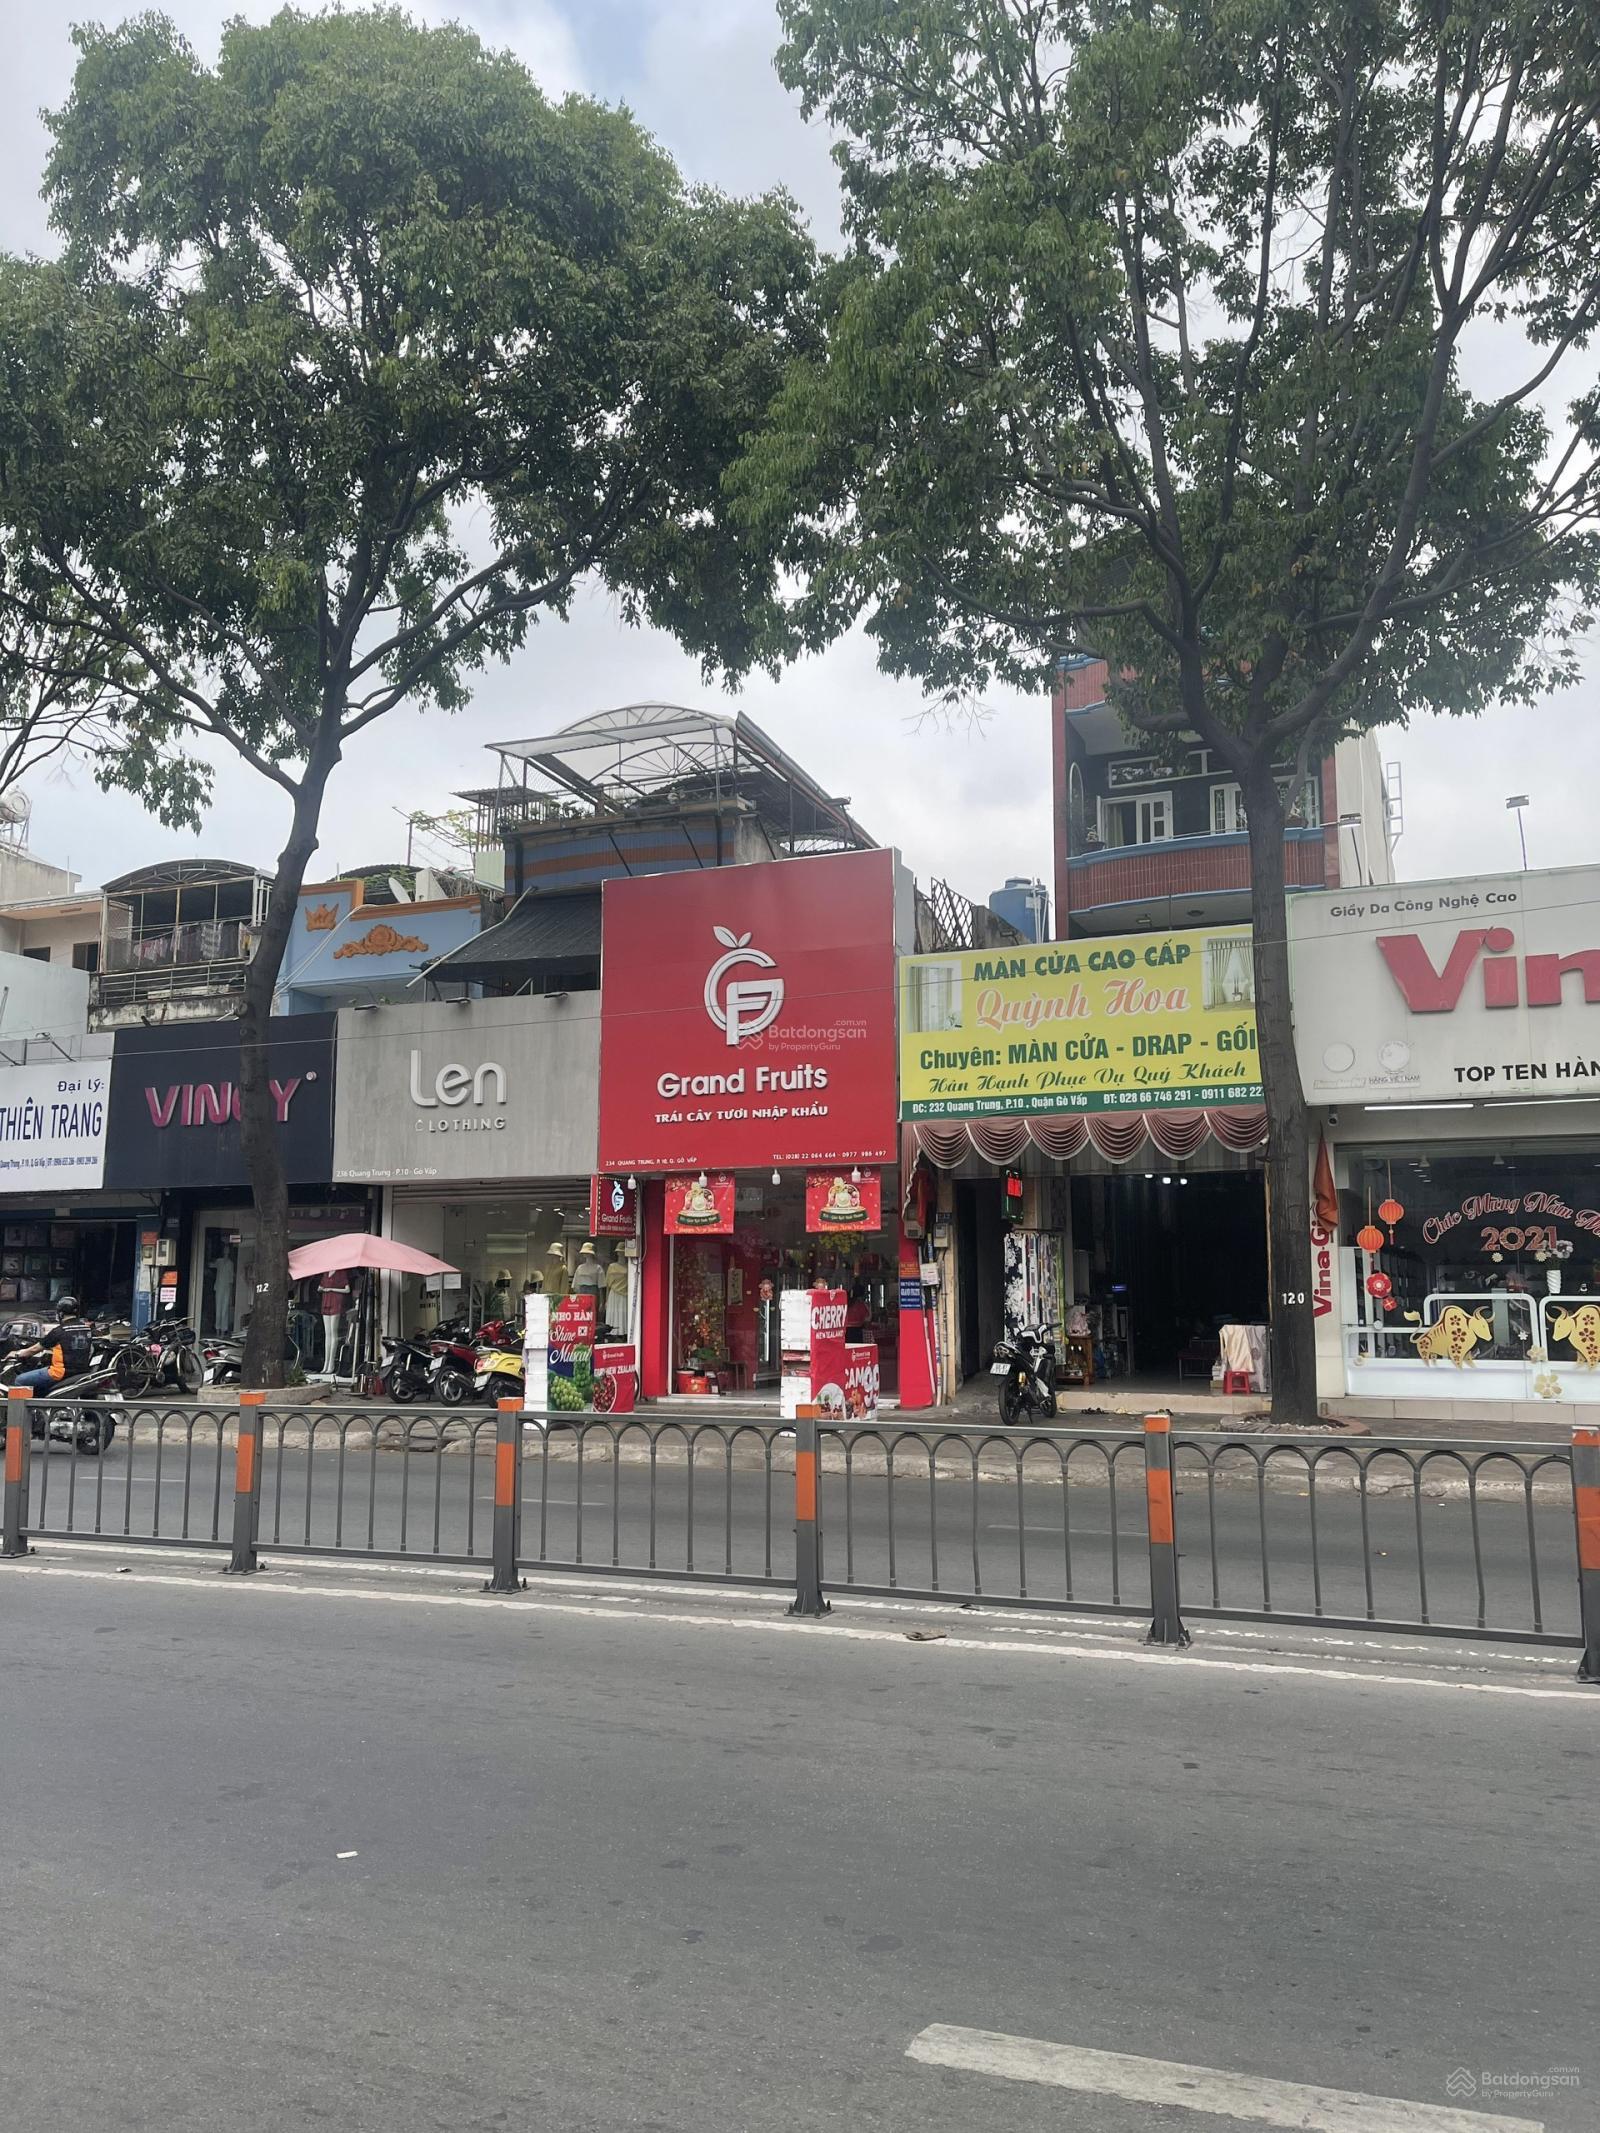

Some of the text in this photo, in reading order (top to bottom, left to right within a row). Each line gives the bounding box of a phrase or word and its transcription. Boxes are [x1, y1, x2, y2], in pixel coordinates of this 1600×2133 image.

[1370, 903, 1390, 914] Da
[1394, 899, 1433, 911] Công
[1439, 894, 1479, 908] Nghệ
[1485, 892, 1517, 904] Cao
[974, 939, 1191, 981] MÀN CỬA CAO CẤP
[975, 977, 1190, 1032] Quỳnh Hoa
[920, 1046, 1001, 1070] Chuyên:
[1008, 1039, 1057, 1065] MÀN
[1065, 1032, 1109, 1060] CỬA
[1133, 1033, 1192, 1057] DRAP
[1217, 1021, 1256, 1052] GỐI
[410, 1050, 507, 1107] Len
[657, 1063, 829, 1098] Grand Fruits
[977, 1073, 1029, 1092] Hạnh
[1036, 1071, 1087, 1090] Phục
[1094, 1068, 1125, 1086] Vụ
[1133, 1065, 1171, 1085] Quý
[1178, 1061, 1246, 1080] Khách
[1454, 1066, 1496, 1083] TOP
[1502, 1063, 1548, 1080] TEN
[57, 1078, 105, 1094] Đại lý:
[1103, 1094, 1118, 1105] ĐT:
[1120, 1092, 1138, 1103] 028
[1139, 1092, 1152, 1103] 66
[1154, 1091, 1172, 1102] 746
[1174, 1089, 1192, 1101] 291
[1201, 1088, 1224, 1100] 0911
[1228, 1086, 1247, 1098] 682
[1249, 1085, 1265, 1097] 22
[144, 1078, 301, 1128] VINY
[654, 1101, 828, 1124] TRÁI CÂY TƯƠI NHẬP KHẨU
[929, 1102, 945, 1113] 232
[946, 1101, 974, 1112] Quang
[976, 1100, 1004, 1111] Trung,
[1006, 1098, 1024, 1109] P.10
[1032, 1096, 1054, 1109] Quận
[1056, 1096, 1069, 1107] Gò
[1071, 1094, 1088, 1107] Vấp
[0, 1096, 103, 1141] THIÊN TRANG
[349, 1169, 371, 1178] Quang
[372, 1168, 391, 1178] Trung
[617, 1159, 636, 1167] QUANG
[1422, 1210, 1462, 1245] Chúc
[1462, 1192, 1520, 1221] Mừng
[1523, 1191, 1574, 1219] Năm
[1480, 1225, 1558, 1251] 2021
[1282, 1292, 1305, 1306] 120
[551, 1309, 593, 1321] NHO HÀN
[811, 1304, 848, 1330] CHERRY
[550, 1325, 577, 1342] Shine
